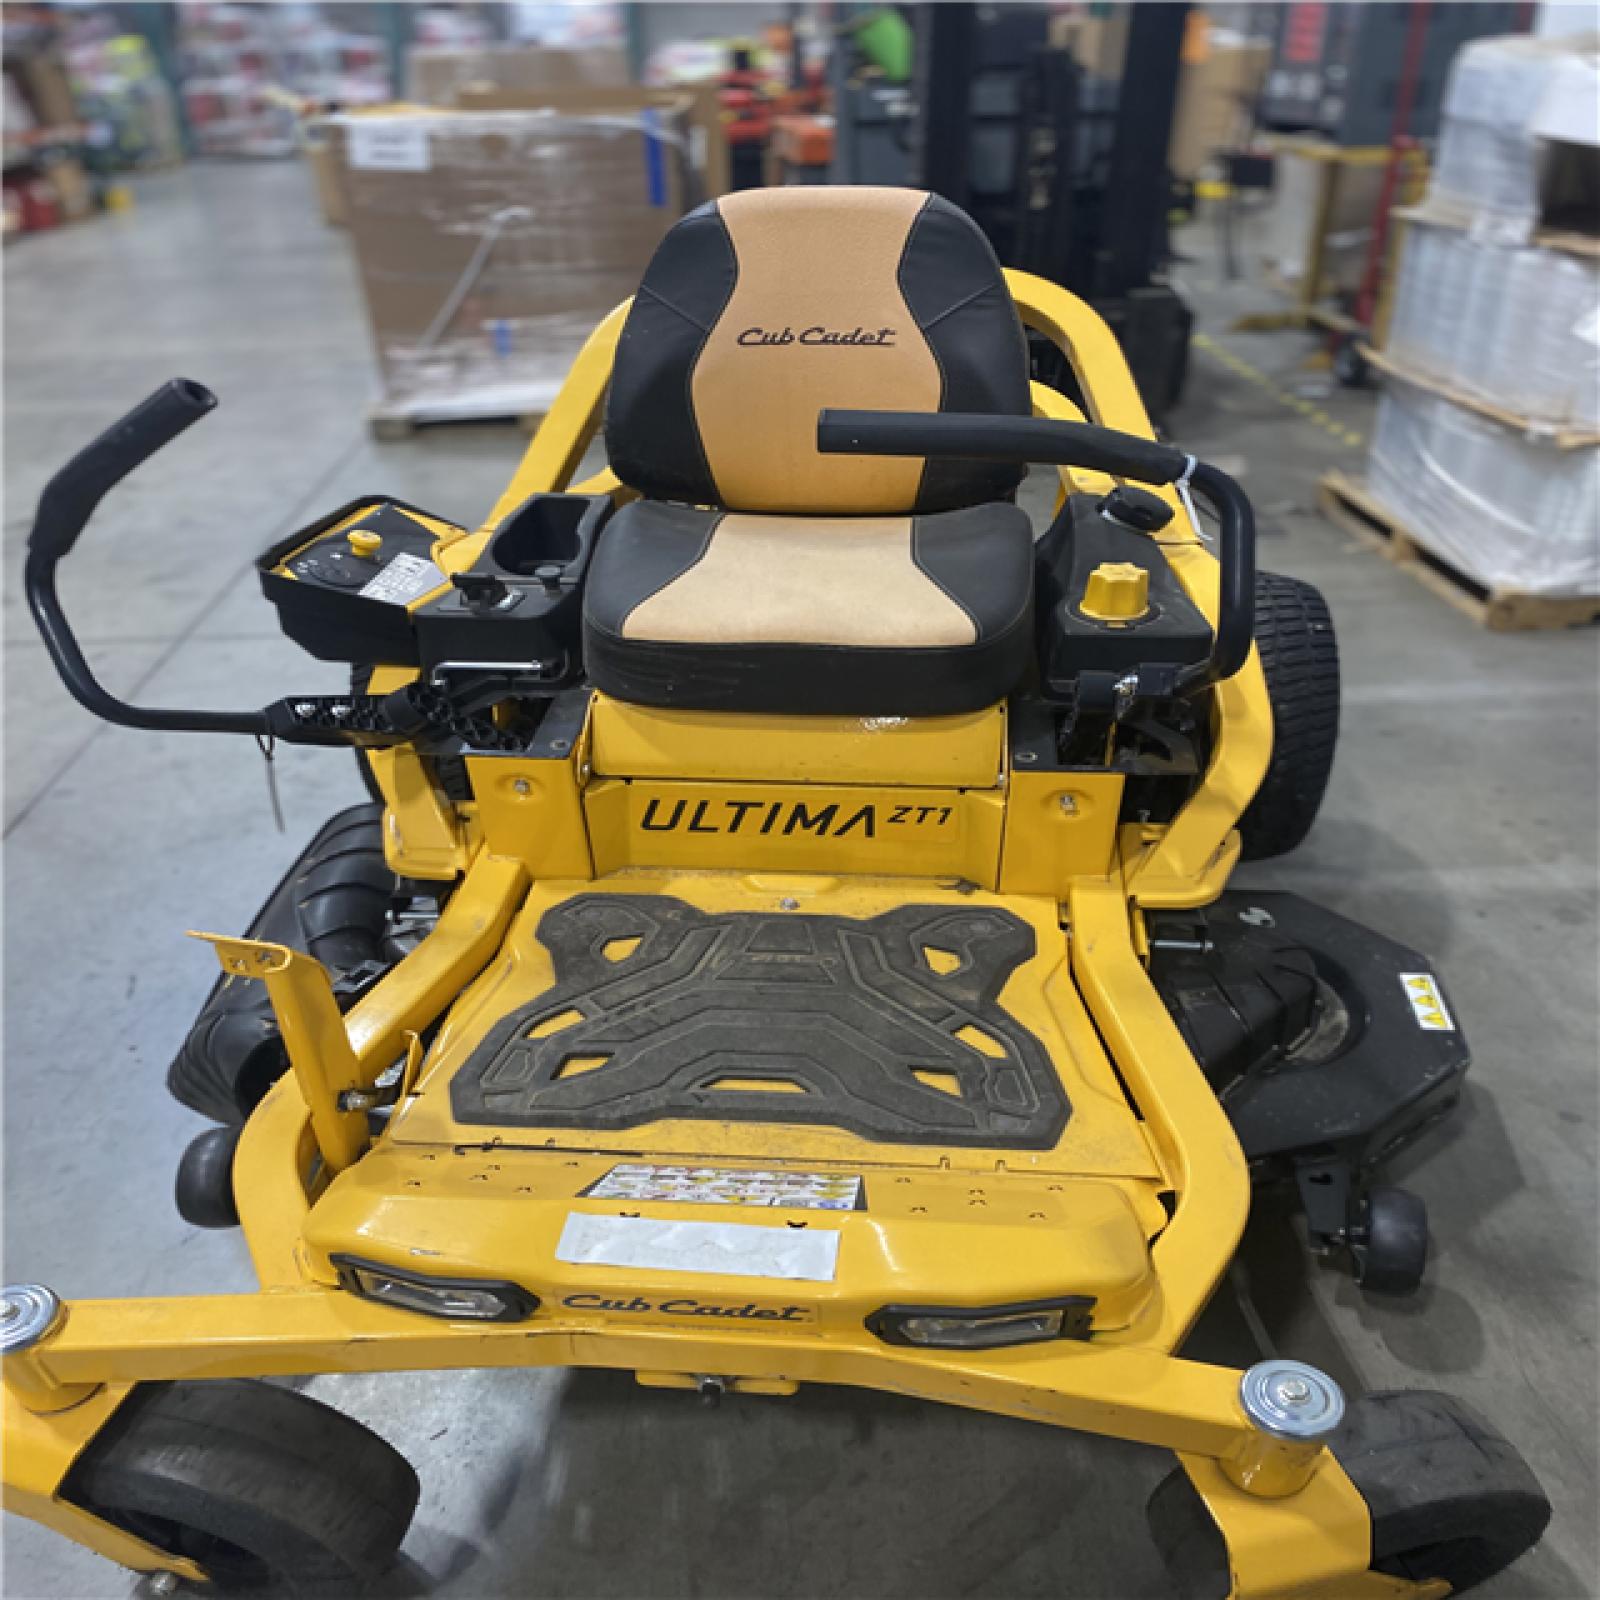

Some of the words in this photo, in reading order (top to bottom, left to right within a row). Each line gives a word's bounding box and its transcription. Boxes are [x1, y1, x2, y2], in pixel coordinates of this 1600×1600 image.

[737, 326, 795, 346] Cub
[798, 326, 896, 346] Cadet
[640, 800, 876, 838] ULTIMA
[887, 805, 953, 825] ZT1
[562, 1294, 651, 1313] Cub
[659, 1300, 810, 1321] Cadet
